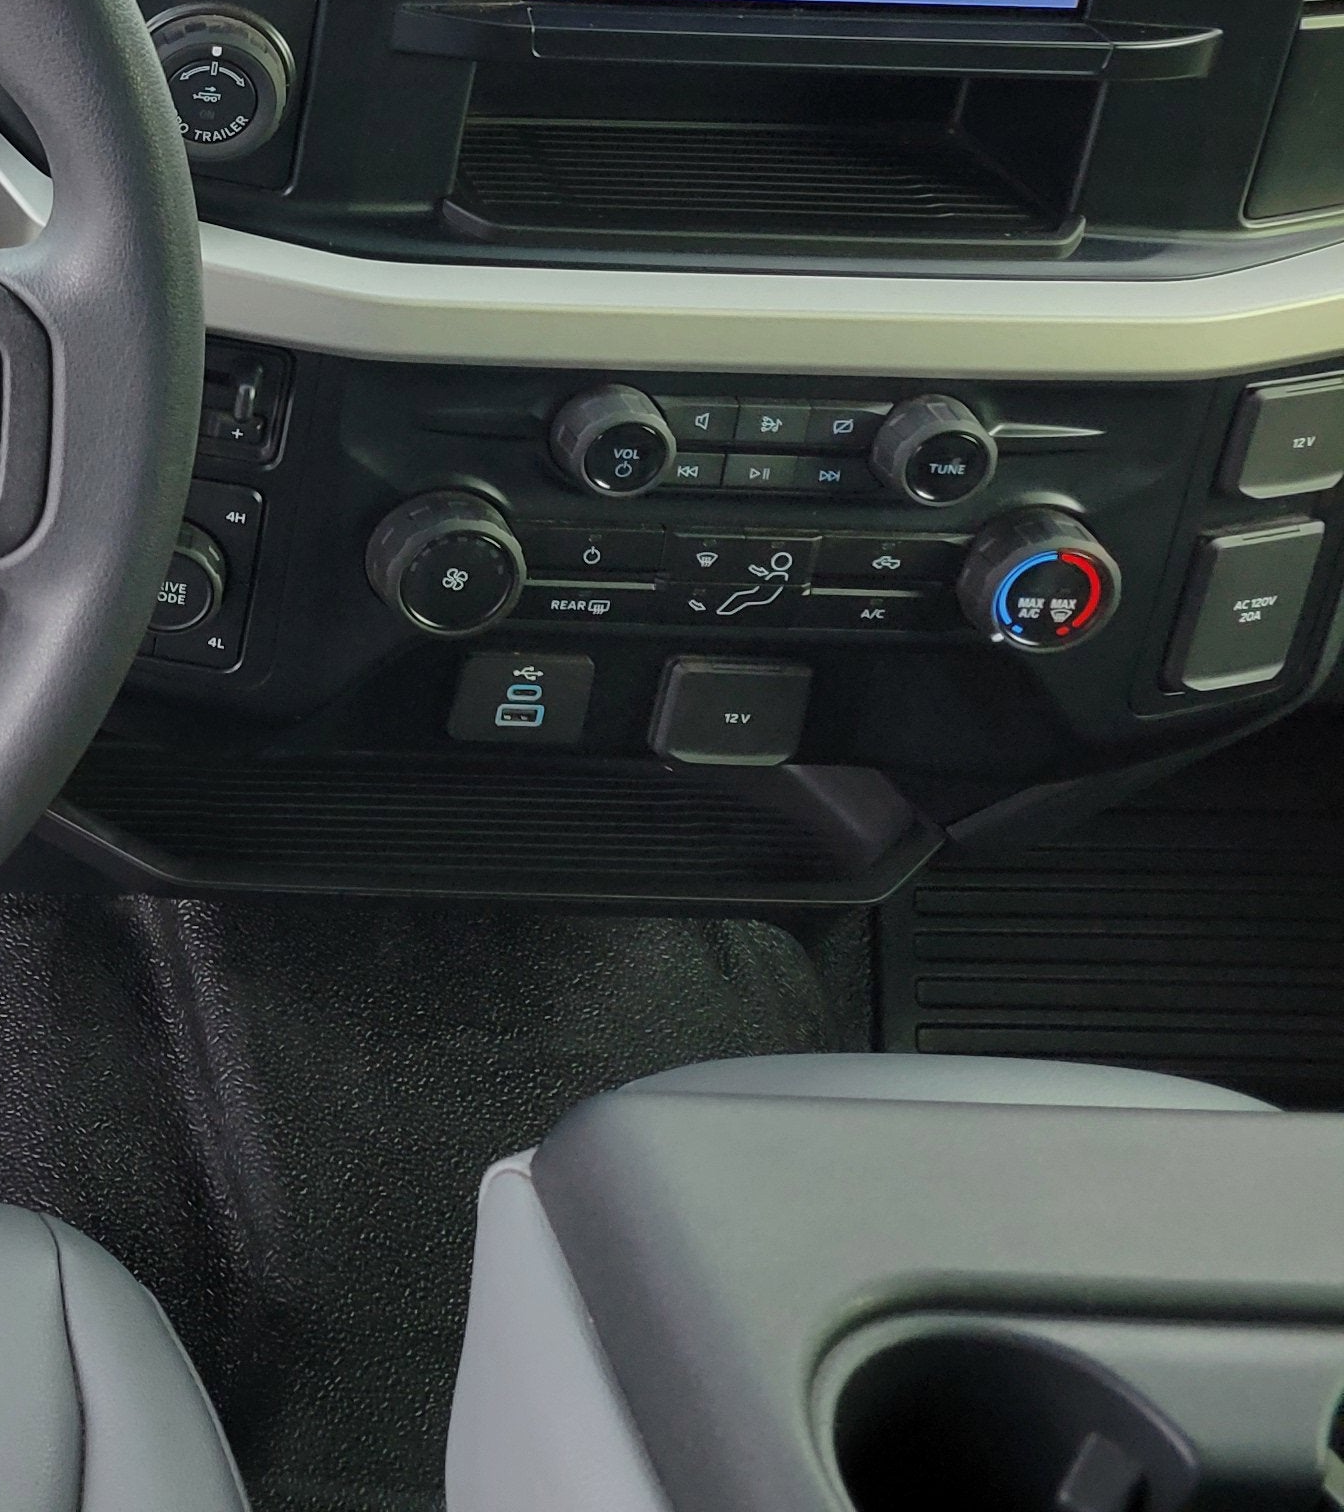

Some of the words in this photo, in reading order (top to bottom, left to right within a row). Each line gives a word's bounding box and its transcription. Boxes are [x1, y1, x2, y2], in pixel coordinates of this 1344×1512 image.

[194, 115, 249, 142] TRAILER
[613, 448, 640, 460] VOL
[929, 463, 967, 476] TUNE
[225, 511, 246, 524] 4H
[157, 591, 186, 606] ODE
[1017, 597, 1045, 609] MAX
[1050, 598, 1077, 610] MAX
[1233, 599, 1251, 611] AC
[1251, 595, 1278, 608] 120V
[550, 599, 587, 612] REAR
[860, 607, 885, 622] A/C
[1018, 608, 1041, 619] A/C
[1239, 610, 1262, 623] 20A
[208, 637, 225, 650] 4L
